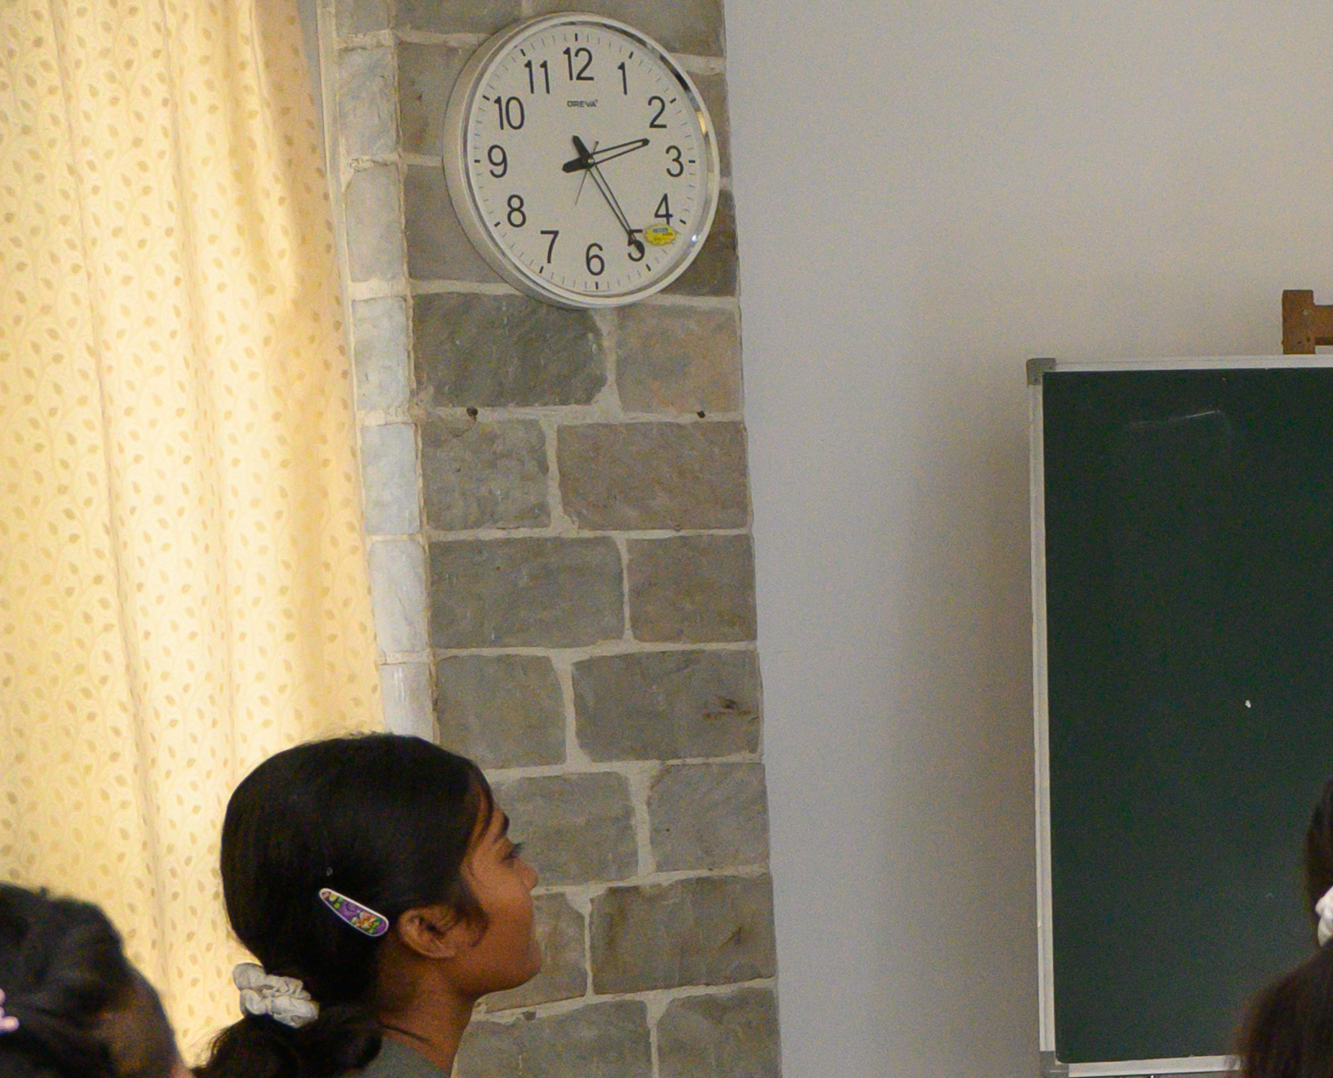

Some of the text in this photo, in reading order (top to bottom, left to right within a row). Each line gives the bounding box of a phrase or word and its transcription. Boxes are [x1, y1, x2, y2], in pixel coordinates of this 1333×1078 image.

[524, 60, 550, 94] 11
[563, 47, 594, 81] 12
[617, 62, 628, 95] 1
[494, 96, 525, 130] 10
[647, 96, 667, 129] 2
[487, 145, 508, 178] 9
[665, 145, 684, 177] 3
[506, 195, 527, 228] 8
[654, 193, 673, 225] 4
[540, 230, 560, 264] 7
[585, 243, 605, 276] 6
[627, 229, 646, 262] 5
